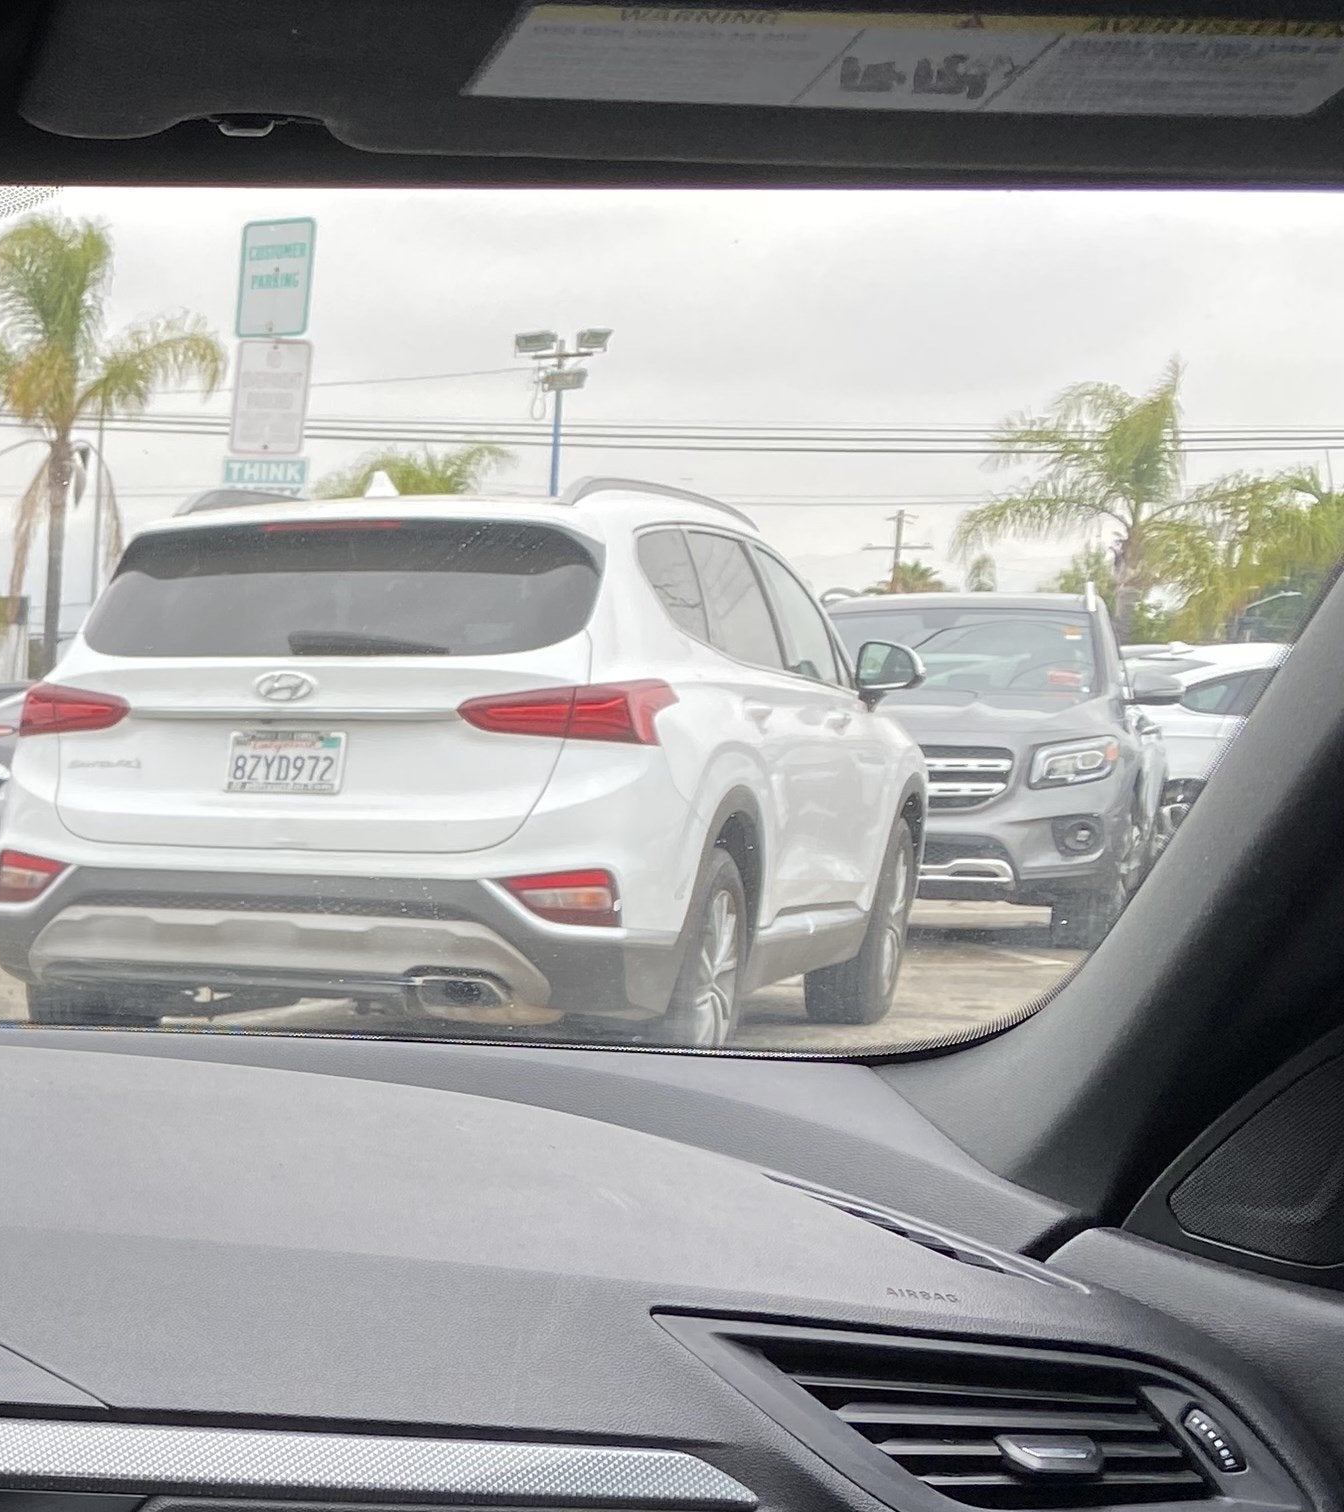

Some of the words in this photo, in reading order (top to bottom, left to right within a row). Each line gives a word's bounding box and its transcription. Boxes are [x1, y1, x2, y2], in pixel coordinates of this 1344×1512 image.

[250, 270, 300, 290] PARKING
[229, 462, 303, 481] THINK
[232, 754, 336, 782] 8ZYD972
[886, 1287, 959, 1303] AIRBAG
